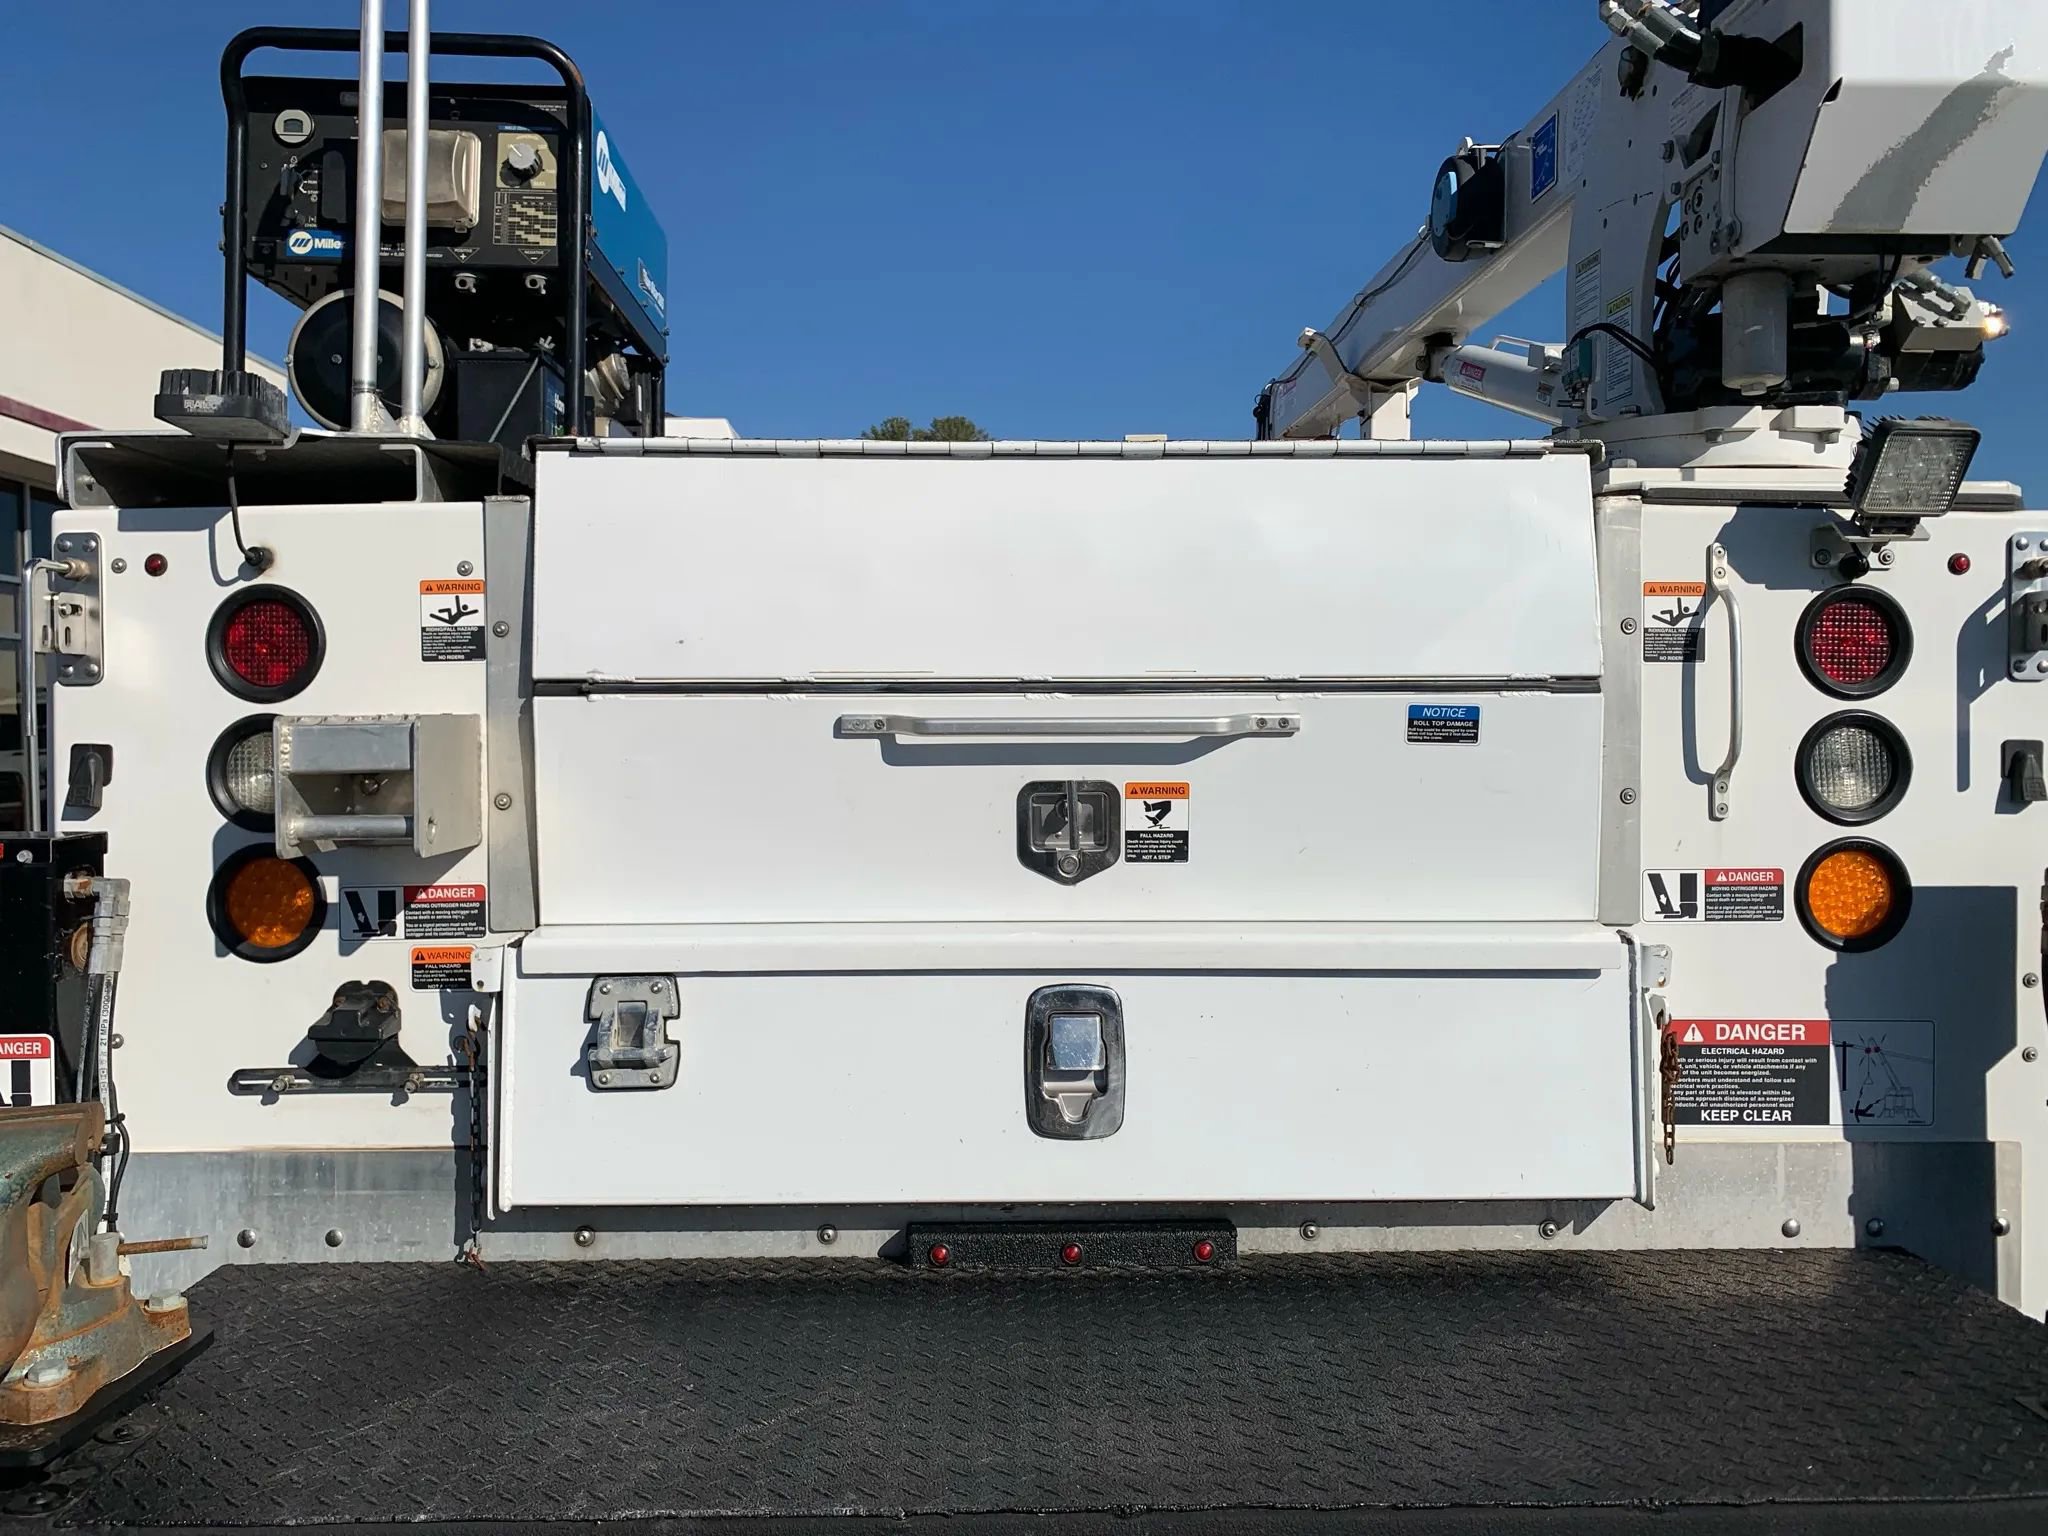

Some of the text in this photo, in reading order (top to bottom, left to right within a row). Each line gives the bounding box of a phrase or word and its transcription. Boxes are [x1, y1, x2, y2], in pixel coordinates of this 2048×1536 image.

[314, 238, 346, 249] Miller
[1422, 707, 1467, 717] NOTICE
[1728, 872, 1774, 881] DANGER
[428, 888, 476, 898] DANGER
[1715, 1023, 1806, 1041] DANGER
[100, 1038, 107, 1047] 21
[1701, 1109, 1792, 1122] KEEP CLEAR
